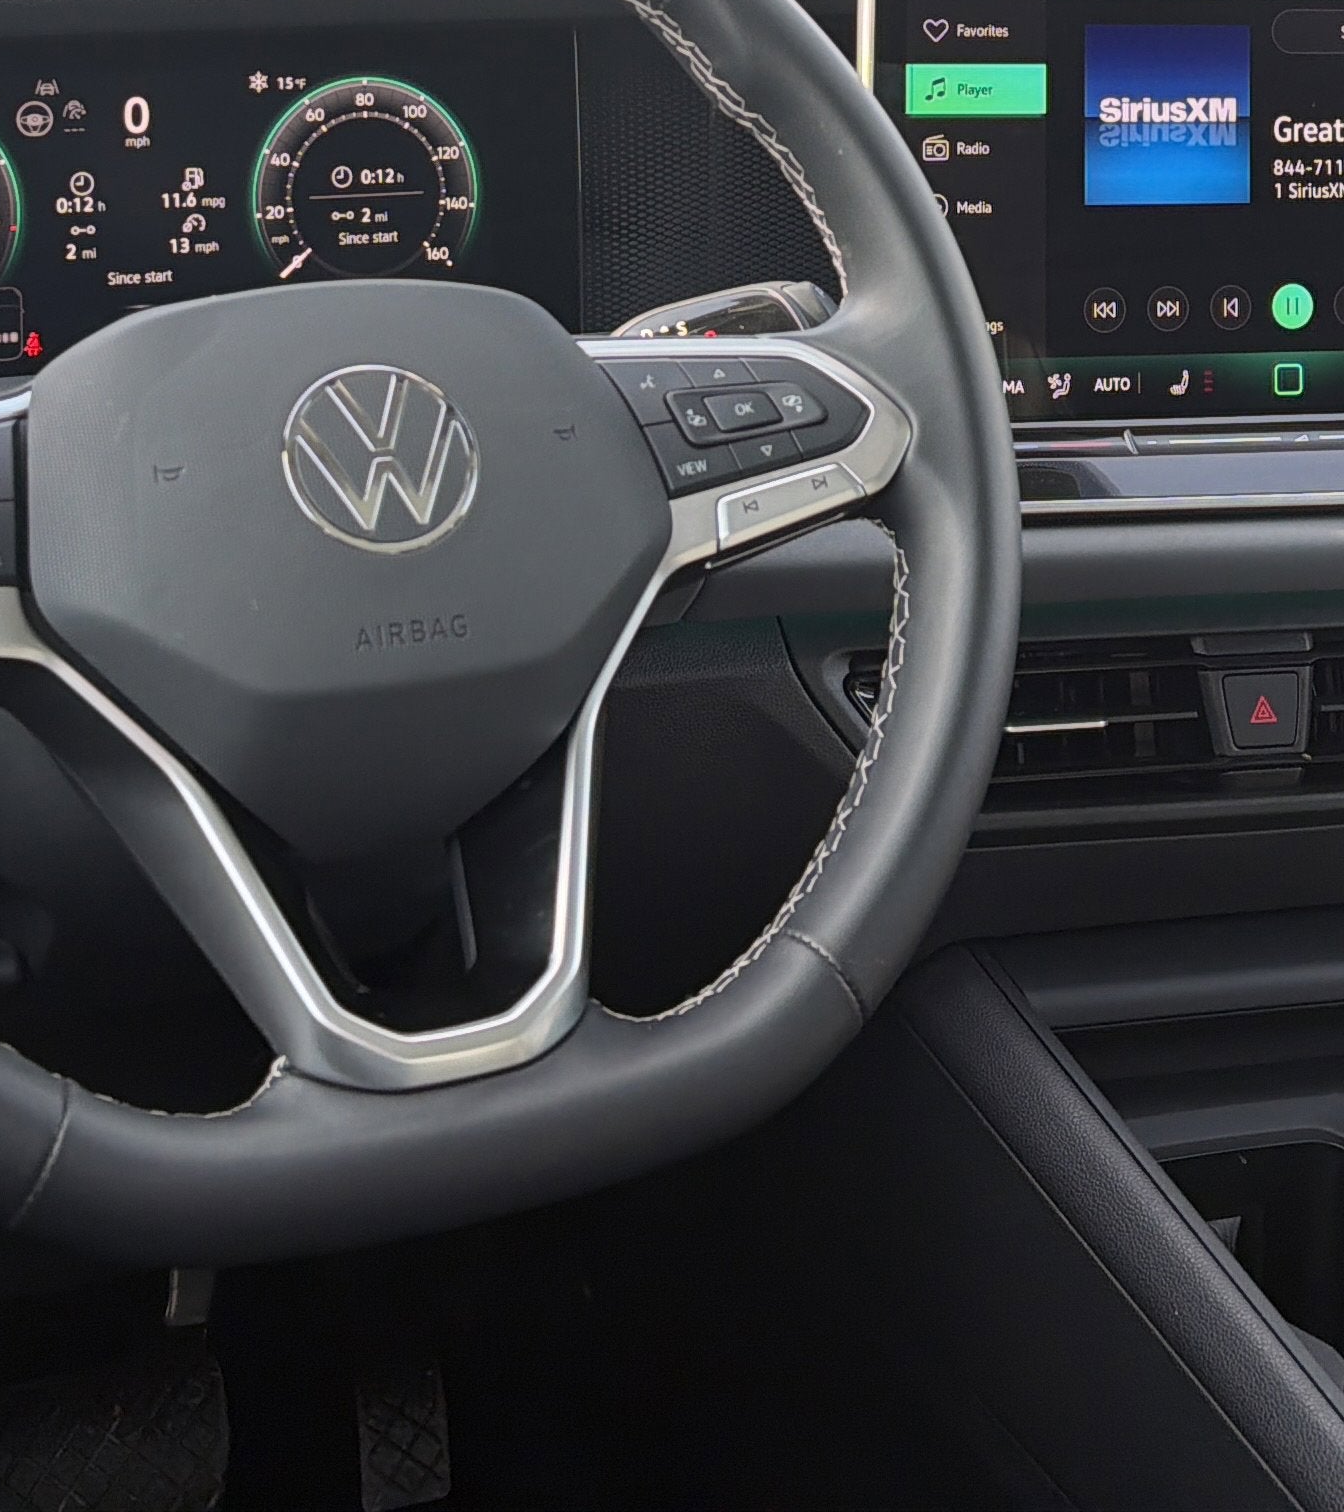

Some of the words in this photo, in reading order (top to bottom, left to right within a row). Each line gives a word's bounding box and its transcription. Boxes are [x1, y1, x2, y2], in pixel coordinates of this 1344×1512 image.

[956, 23, 1009, 38] Favorites
[957, 83, 993, 99] Player
[355, 92, 375, 106] 80
[124, 96, 150, 134] 0
[305, 108, 326, 122] 60
[402, 104, 427, 119] 100
[1099, 97, 1238, 123] SiriusXM
[1273, 115, 1344, 144] Great
[124, 135, 151, 149] mph
[956, 142, 990, 155] Radio
[270, 152, 291, 167] 40
[437, 146, 460, 160] 120
[360, 169, 395, 185] 0:12
[396, 172, 405, 184] h
[1274, 182, 1283, 199] 1
[55, 196, 94, 214] 0:12
[97, 200, 107, 212] h
[161, 191, 198, 209] 11.6
[201, 196, 226, 209] mpg
[445, 196, 468, 210] 140
[956, 200, 993, 215] Media
[265, 206, 285, 220] 20
[361, 208, 371, 223] 2
[374, 211, 389, 223] mi
[169, 237, 191, 255] 13
[194, 241, 220, 254] mph
[271, 235, 290, 245] mph
[338, 232, 370, 246] Since
[372, 231, 399, 244] start
[64, 243, 77, 260] 2
[81, 247, 97, 260] mi
[425, 246, 450, 261] 160
[107, 271, 142, 286] Since
[145, 269, 175, 284] start
[1094, 377, 1131, 393] AUTO
[734, 400, 755, 417] OK
[676, 458, 708, 478] VIEW
[356, 613, 469, 652] AIRBAG
